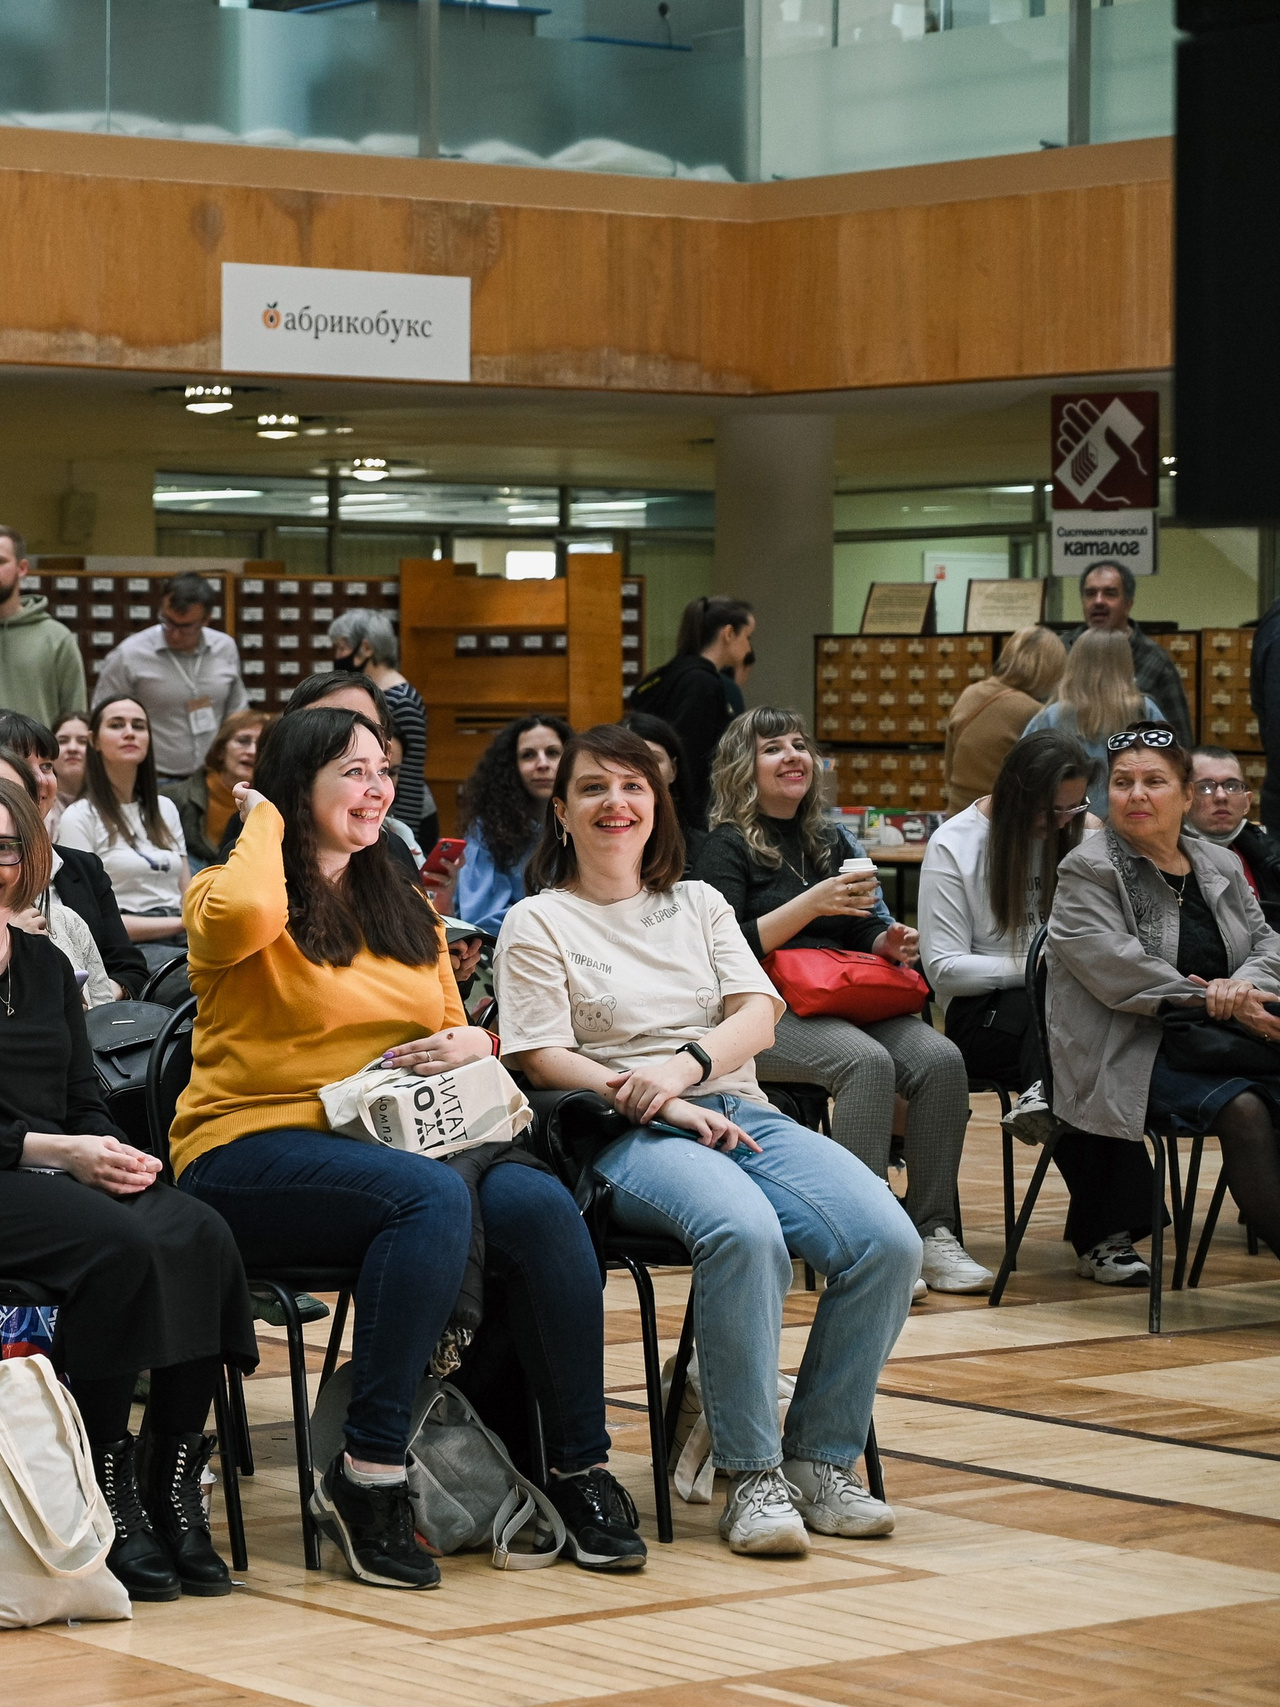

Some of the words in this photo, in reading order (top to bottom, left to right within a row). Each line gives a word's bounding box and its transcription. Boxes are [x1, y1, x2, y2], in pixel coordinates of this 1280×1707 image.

[284, 306, 433, 343] абрикобукс
[1057, 525, 1148, 538] Систематический
[1064, 540, 1140, 556] каталог
[640, 914, 657, 928] НЕ
